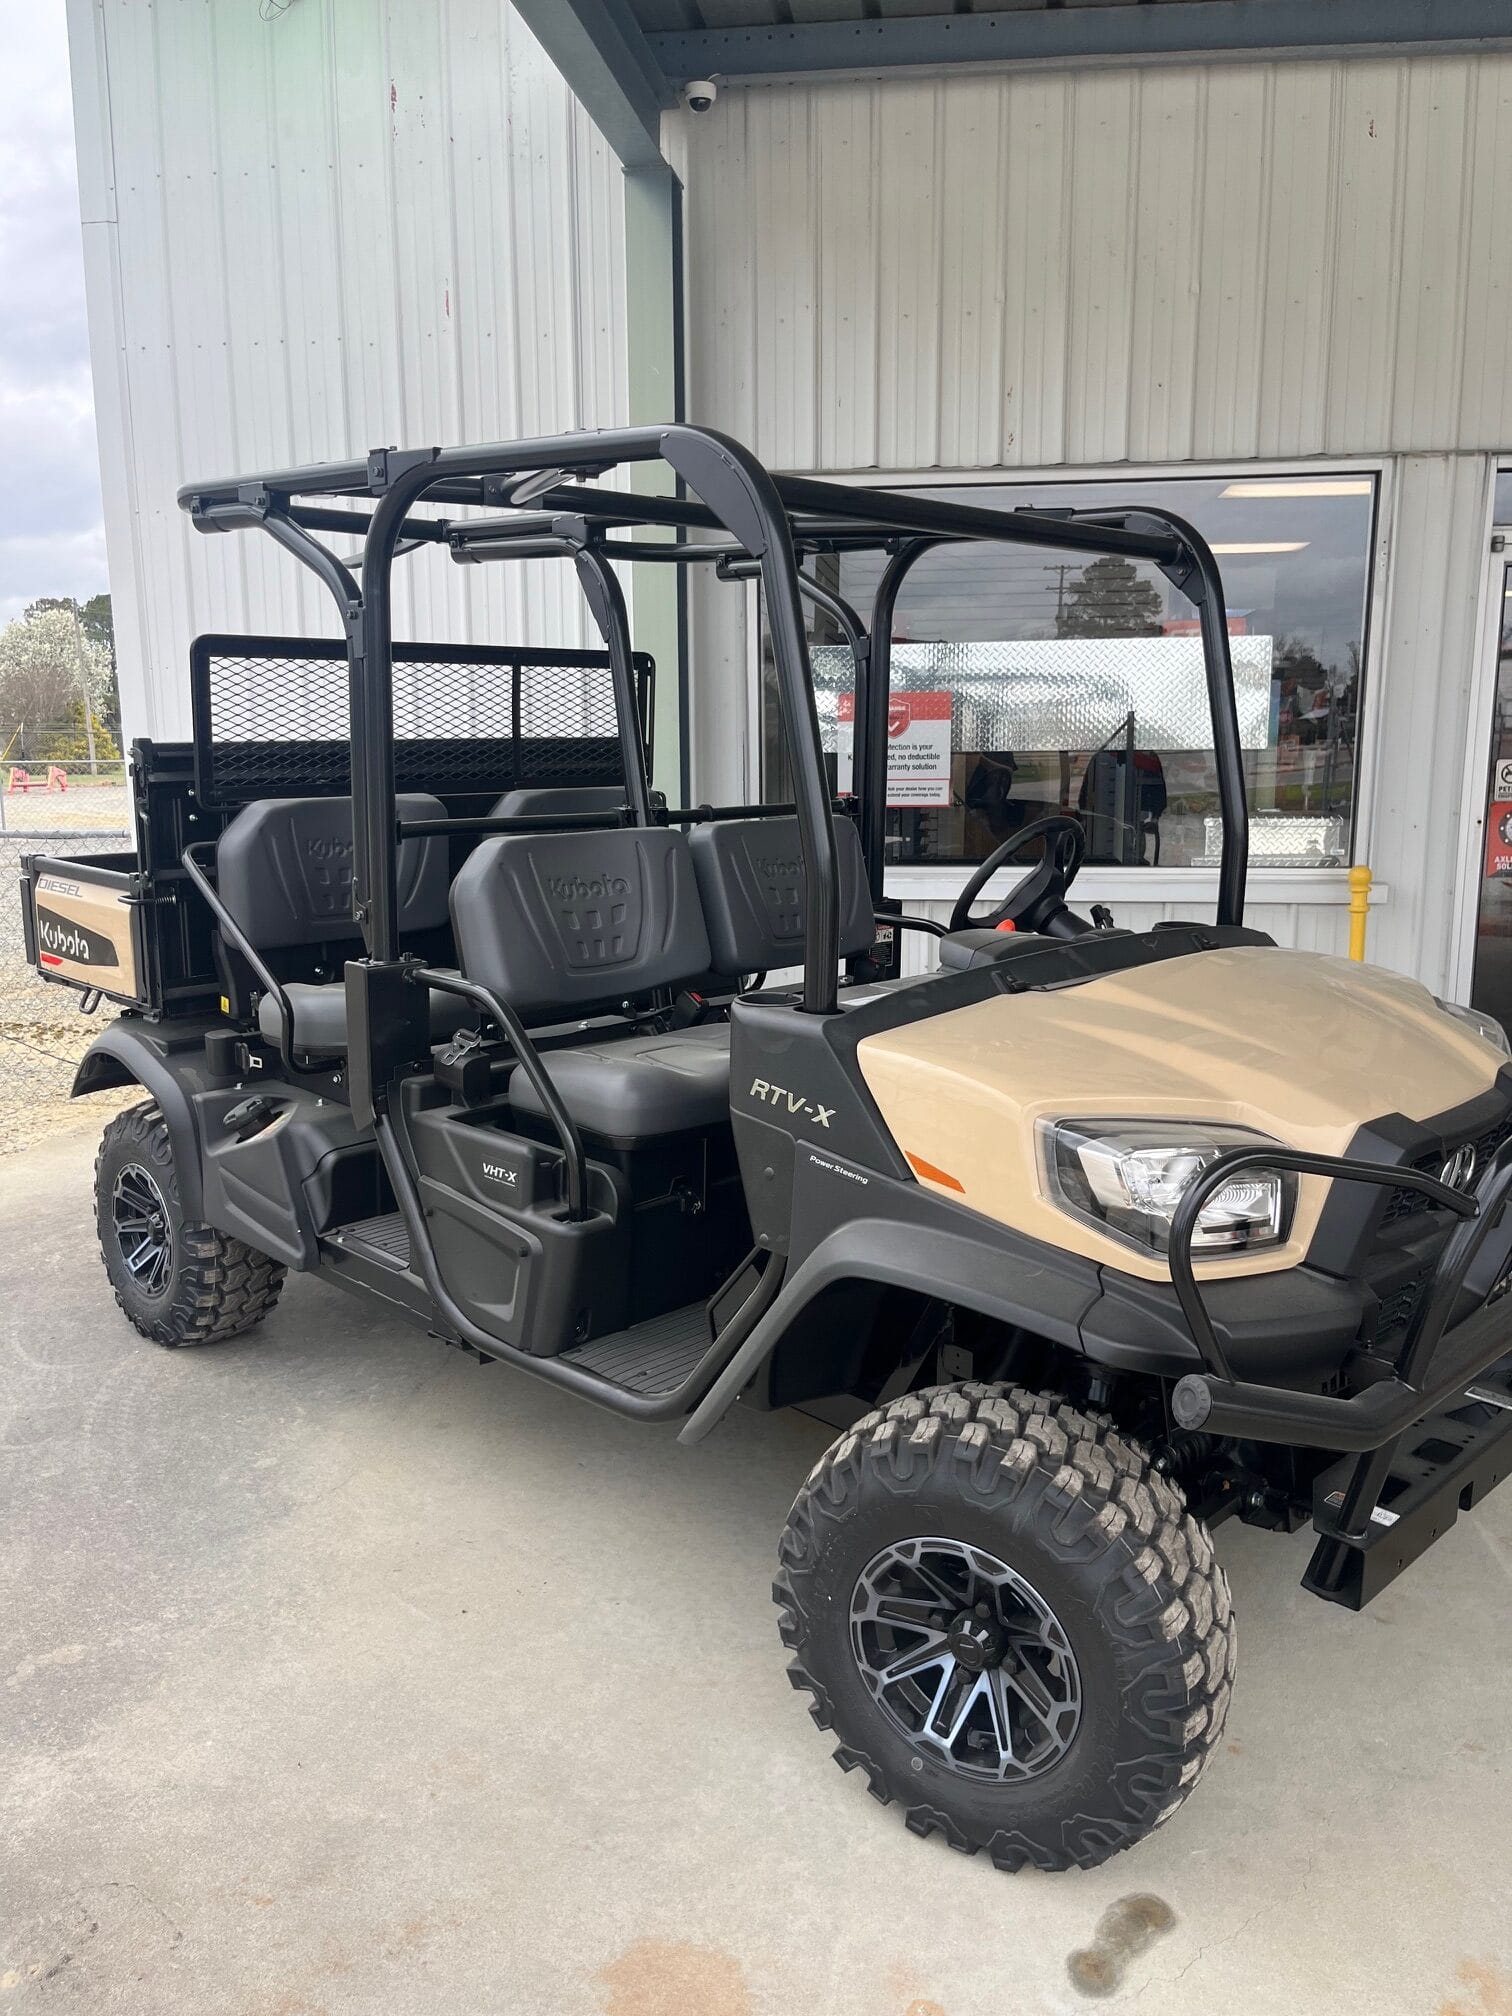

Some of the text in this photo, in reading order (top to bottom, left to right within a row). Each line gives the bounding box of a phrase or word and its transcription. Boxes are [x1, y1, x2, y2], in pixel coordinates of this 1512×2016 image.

[888, 753, 897, 761] ed,
[38, 878, 83, 898] DIESEL
[547, 873, 632, 901] Kubota
[40, 920, 90, 960] Kubota
[750, 1078, 836, 1128] RTV-X
[482, 1162, 518, 1182] VHT-X
[810, 1154, 869, 1185] Power Steering
